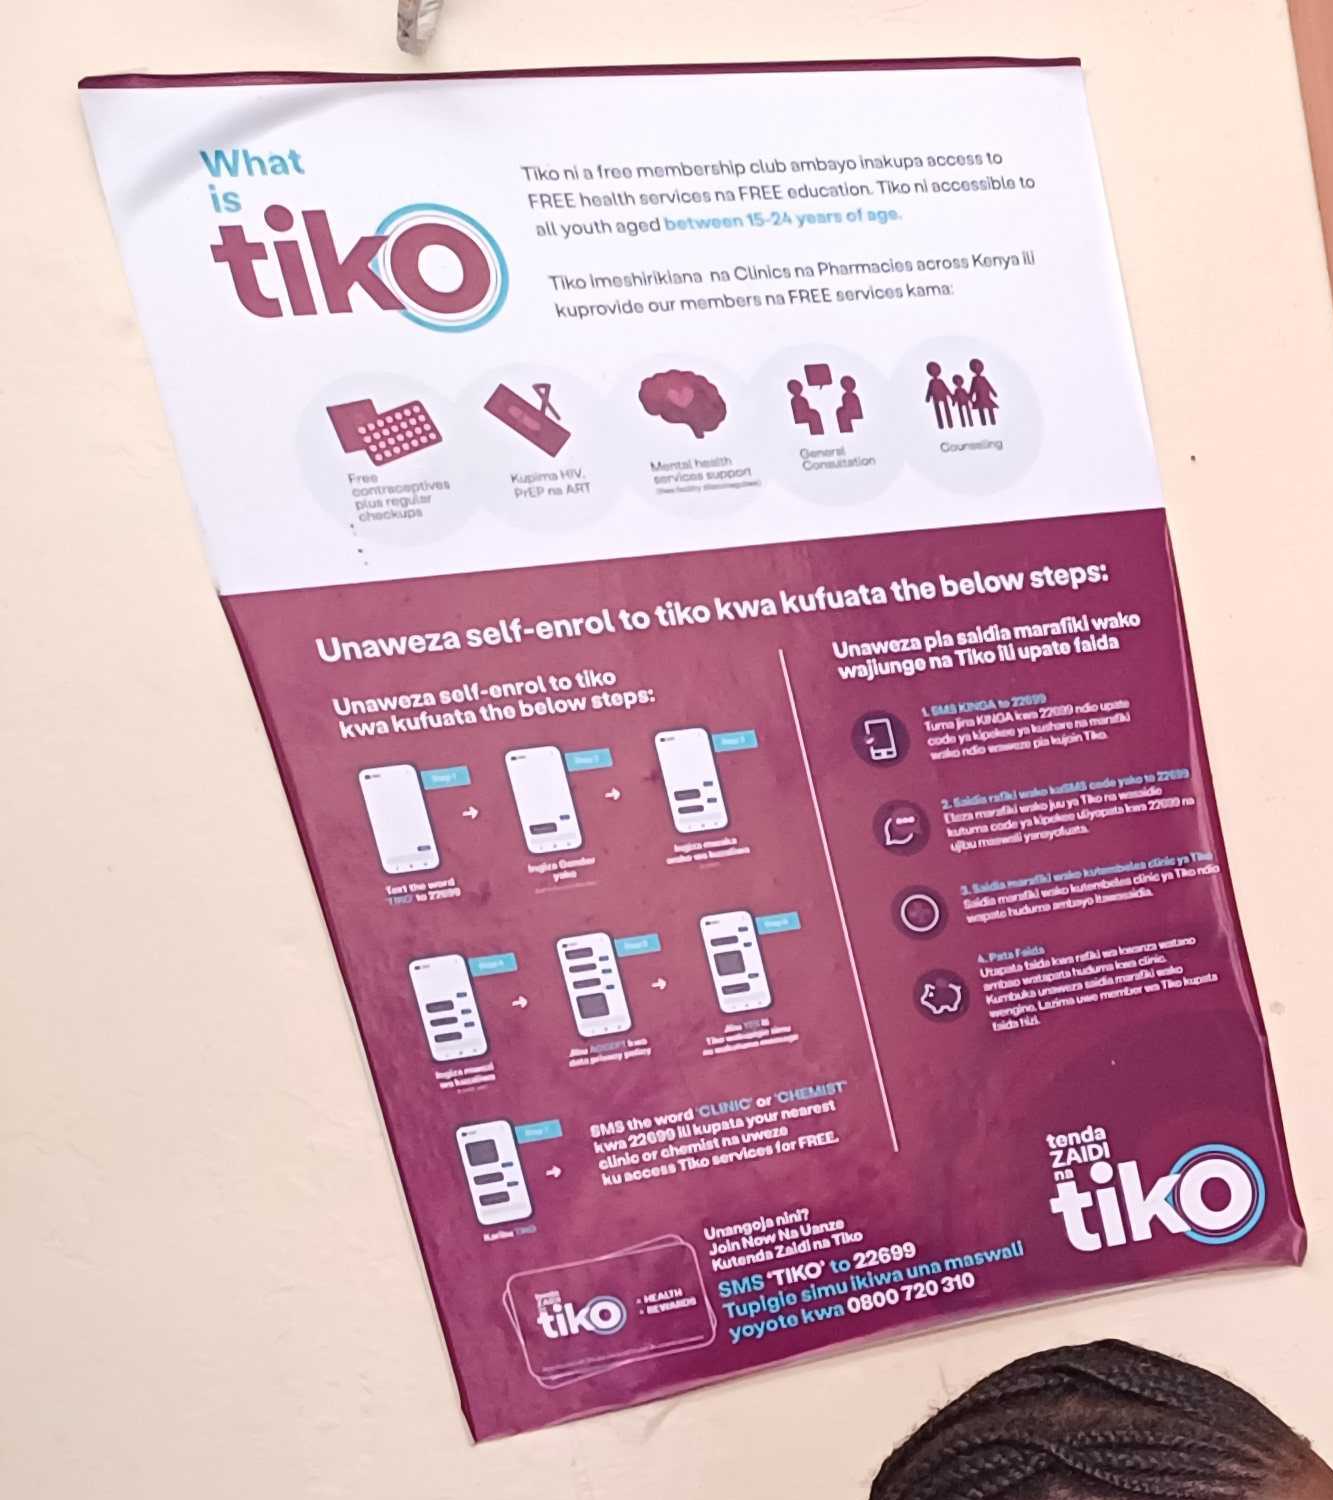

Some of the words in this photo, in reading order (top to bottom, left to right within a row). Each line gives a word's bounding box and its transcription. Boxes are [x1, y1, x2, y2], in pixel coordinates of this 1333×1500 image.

[200, 148, 305, 178] What
[520, 166, 560, 181] Tiko
[563, 166, 579, 180] ni
[583, 168, 594, 180] a
[597, 164, 633, 179] free
[636, 160, 746, 178] membership
[750, 158, 787, 174] club
[790, 157, 857, 174] ambayo
[859, 155, 924, 171] inakupa
[926, 154, 983, 167] access
[986, 152, 1003, 165] to
[208, 183, 242, 214] is
[528, 192, 576, 209] FREE
[579, 191, 636, 207] health
[639, 189, 712, 205] services
[714, 190, 736, 202] na
[738, 184, 783, 201] FREE
[787, 182, 873, 199] education.
[876, 180, 911, 194] Tiko
[914, 179, 928, 193] ni
[931, 176, 1016, 193] accessible
[1019, 176, 1035, 189] to
[536, 221, 558, 237] all
[560, 219, 612, 240] youth
[616, 217, 661, 237] aged
[663, 217, 744, 231] between
[746, 211, 793, 227] 15-24
[795, 212, 843, 228] years
[845, 208, 863, 223] of
[867, 209, 902, 225] age.
[210, 204, 491, 319] tiko
[548, 275, 587, 291] Tiko
[589, 270, 703, 288] imeshirikiana
[710, 270, 731, 282] na
[734, 264, 791, 281] Clinics
[794, 266, 815, 278] na
[817, 258, 913, 276] Pharmacies
[916, 258, 969, 271] across
[971, 253, 1020, 270] Kenya
[1022, 250, 1035, 265] ili
[554, 299, 644, 320] kuprovide
[648, 300, 676, 313] our
[680, 294, 762, 311] members
[765, 294, 786, 306] na
[787, 287, 832, 304] FREE
[836, 285, 903, 302] services
[315, 631, 461, 662] Unaweza
[466, 608, 616, 647] self-enrol
[618, 609, 651, 630] to
[654, 601, 711, 627] tiko
[714, 597, 777, 620] kwa
[779, 584, 887, 614] kufuata
[890, 578, 936, 602] the
[939, 571, 1024, 597] below
[1030, 564, 1109, 590] steps:
[1046, 1125, 1107, 1150] tenda
[1049, 1142, 1111, 1169] ZAIDI
[1054, 1168, 1074, 1181] na
[1049, 1158, 1253, 1252] tiko
[703, 1215, 774, 1241] Unangoja
[775, 1207, 810, 1228] nini?
[709, 1239, 741, 1257] Join
[742, 1233, 777, 1250] Now
[777, 1228, 799, 1241] Na
[799, 1219, 845, 1237] Uanze
[711, 1249, 774, 1272] Kutenda
[774, 1239, 811, 1259] Zaidi
[812, 1239, 831, 1250] na
[831, 1231, 864, 1246] Tiko
[718, 1273, 765, 1298] SMS
[831, 1259, 851, 1274] to
[853, 1241, 917, 1270] 22699
[722, 1293, 798, 1319] Tupigie
[801, 1279, 849, 1303] simu
[850, 1268, 904, 1292] ikiwa
[906, 1264, 942, 1280] una
[944, 1240, 1024, 1272] maswali
[728, 1315, 799, 1344] yoyote
[801, 1303, 846, 1325] kwa
[846, 1289, 900, 1314] 0800
[902, 1280, 940, 1302] 720
[941, 1272, 975, 1294] 310
